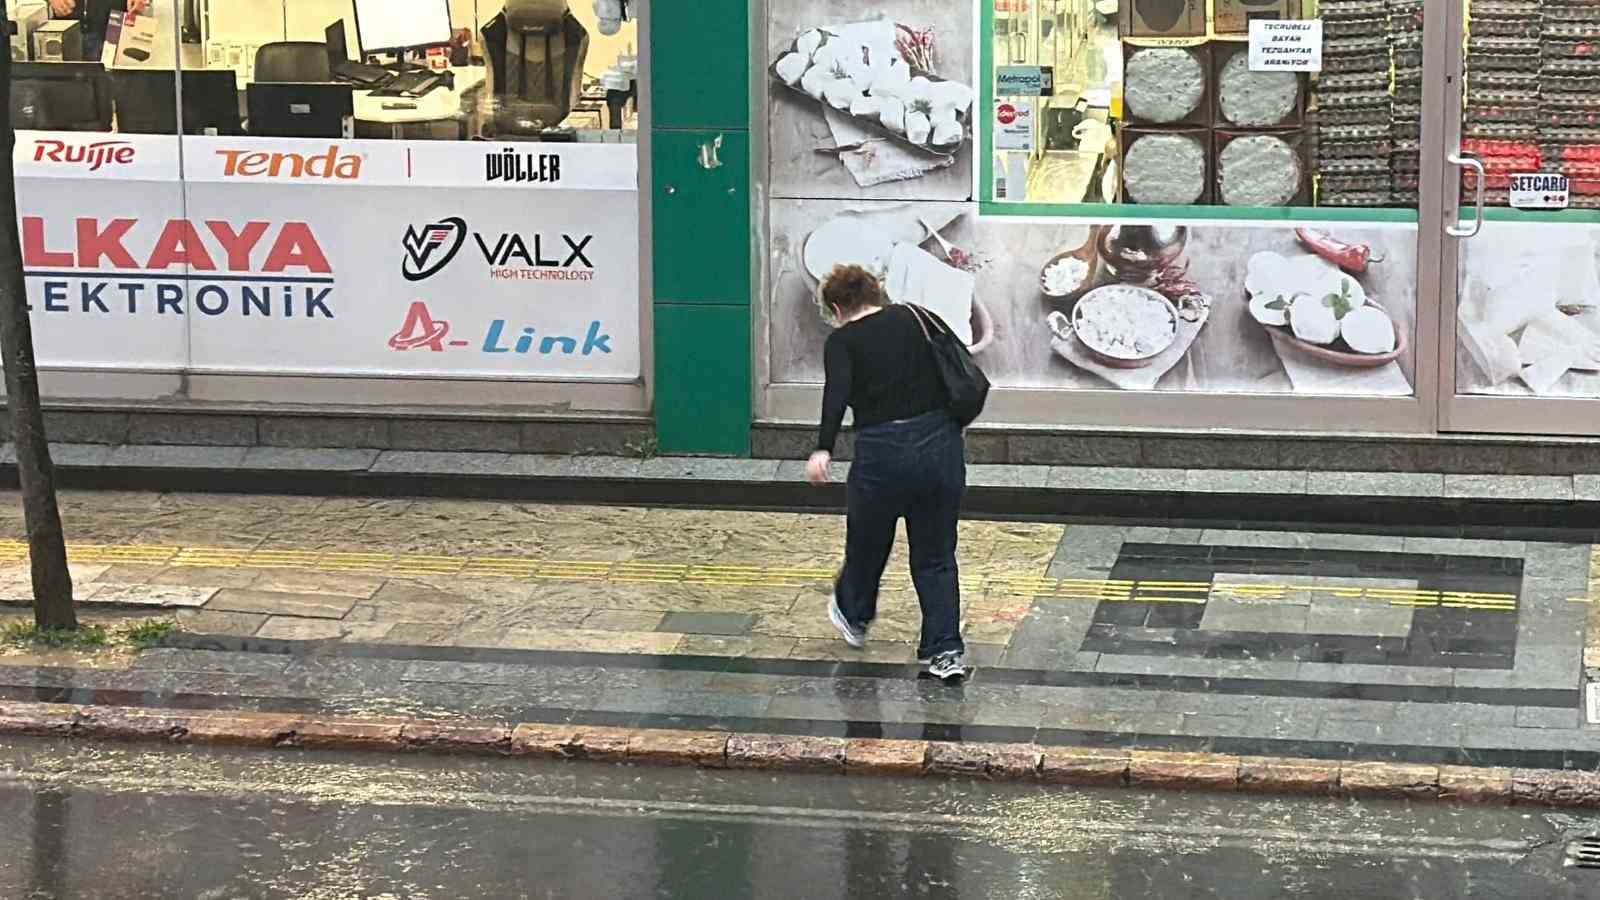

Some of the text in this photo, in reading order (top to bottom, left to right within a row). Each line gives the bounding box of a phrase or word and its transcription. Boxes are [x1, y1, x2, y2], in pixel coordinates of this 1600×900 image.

[34, 140, 135, 171] Ruijie
[215, 145, 362, 179] Tenda
[486, 148, 560, 182] WÖLLER
[1511, 175, 1568, 191] SETCARD
[22, 217, 333, 273] LKAYA
[473, 232, 594, 268] VALX
[490, 268, 595, 281] HIGH TECHNOLOGY
[25, 281, 335, 318] EKTRONiK
